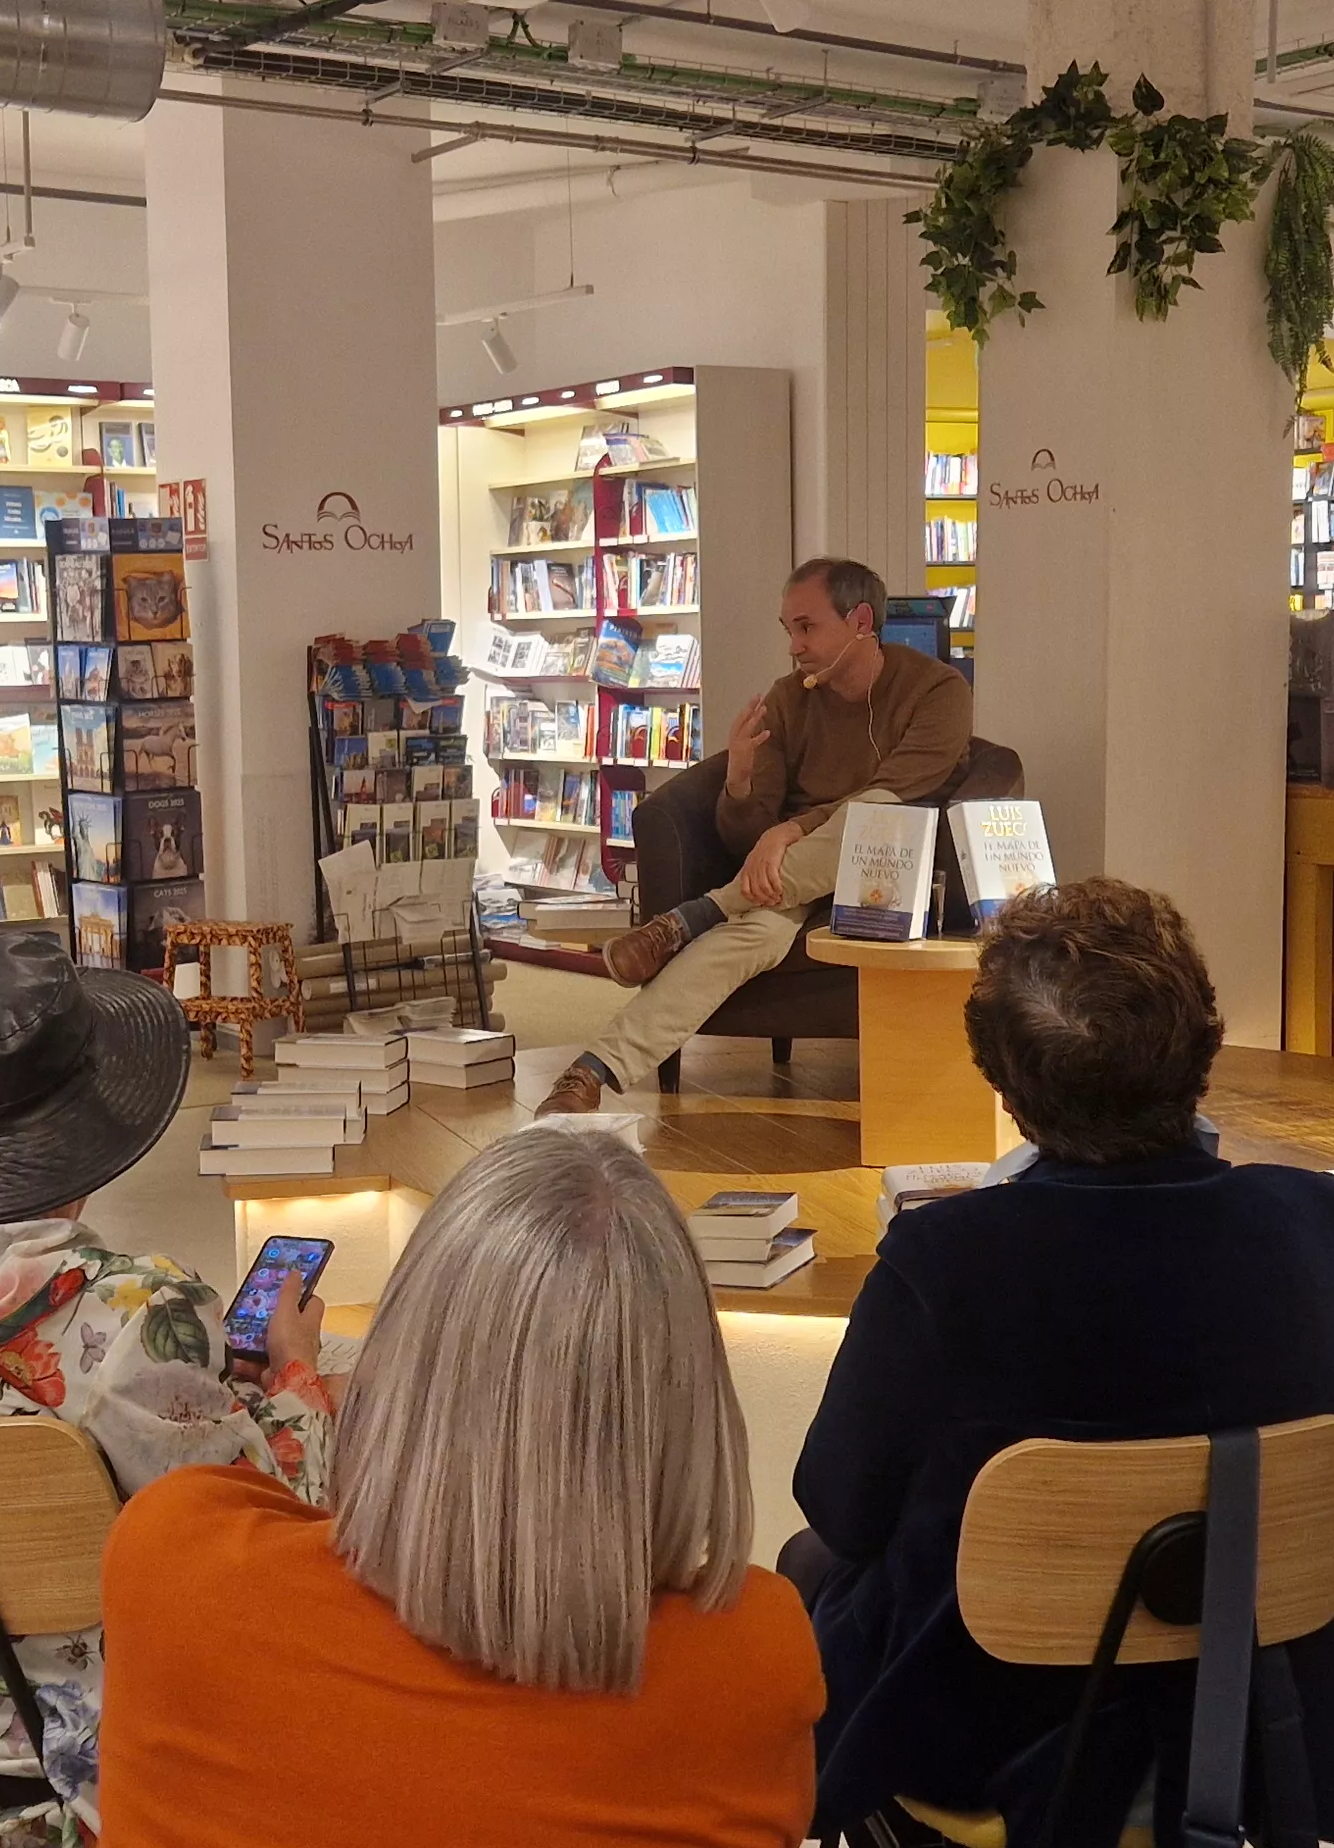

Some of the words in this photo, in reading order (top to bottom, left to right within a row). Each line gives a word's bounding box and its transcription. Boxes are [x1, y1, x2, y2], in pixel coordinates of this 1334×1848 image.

[148, 799, 169, 809] DOGS
[988, 805, 1024, 821] LUIS
[854, 844, 864, 854] EL
[867, 844, 897, 857] MAPA
[899, 848, 915, 859] DE
[1004, 852, 1044, 863] MUNDO
[851, 855, 867, 866] UN
[869, 857, 914, 871] MUNDO
[999, 862, 1036, 873] NUEVO
[860, 868, 900, 881] NUEVO
[153, 887, 172, 898] CATS
